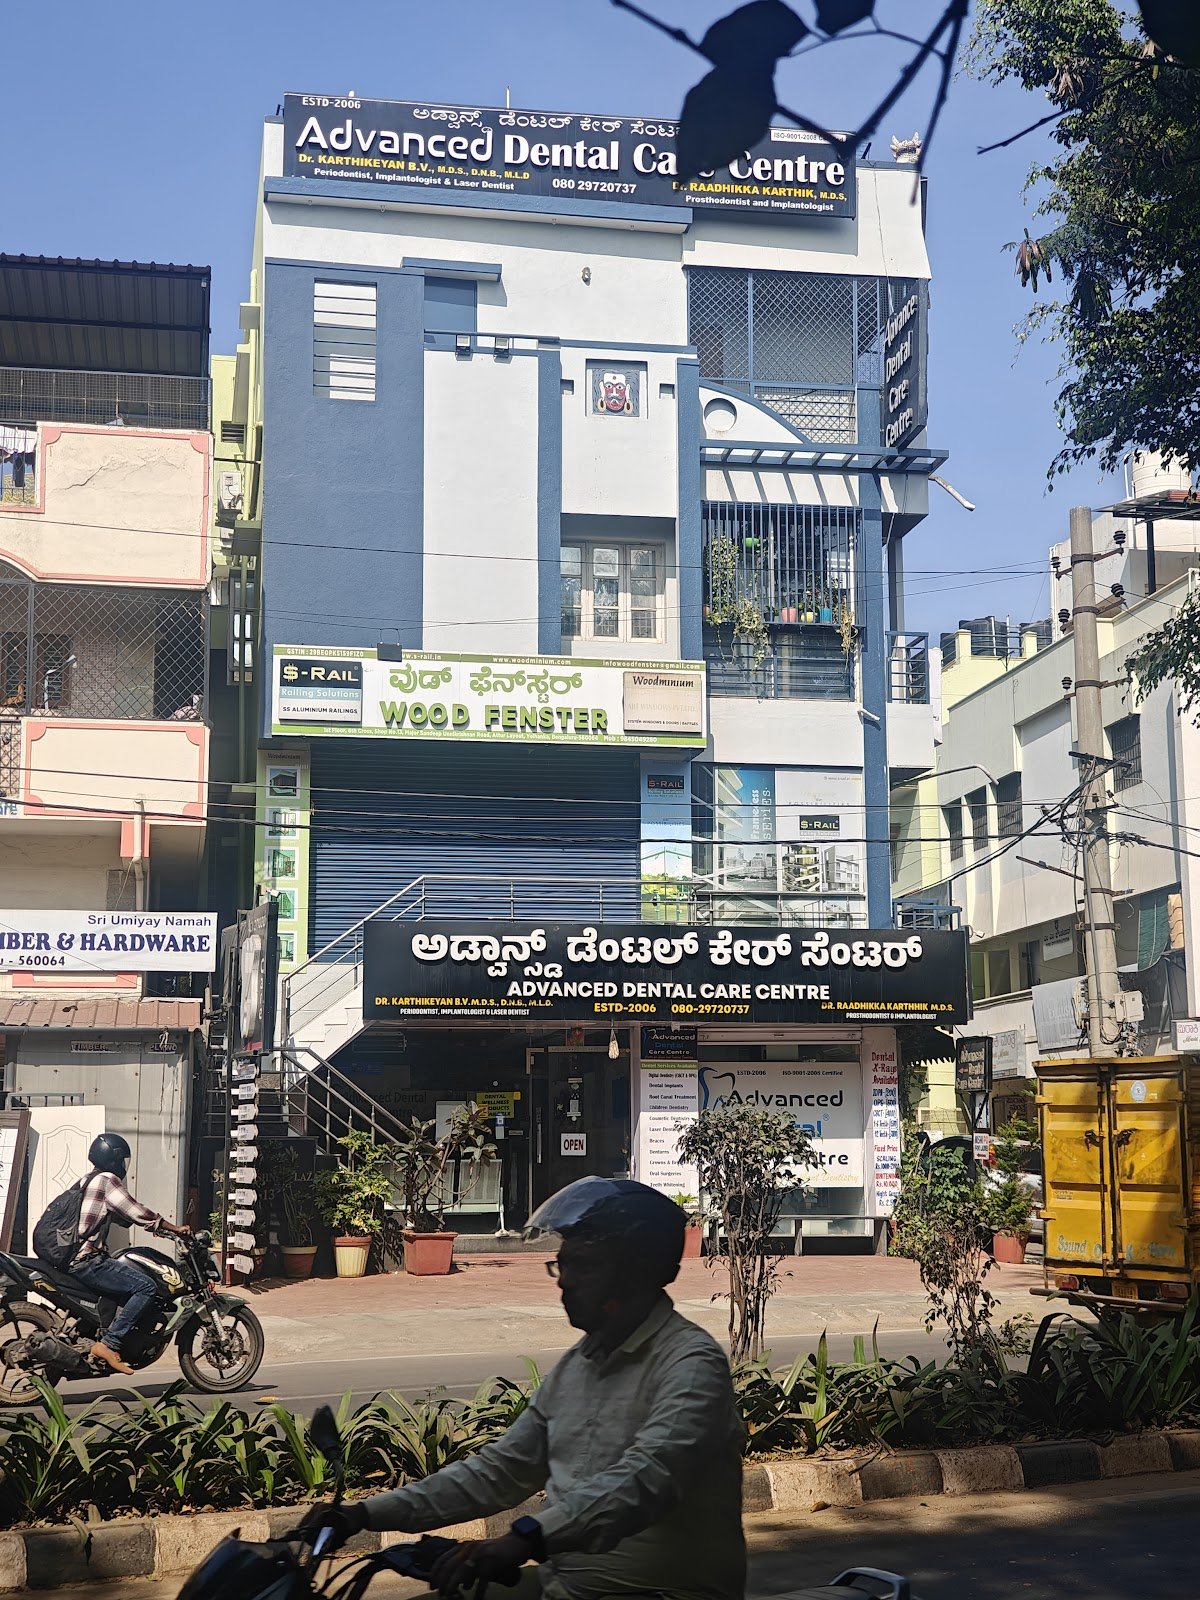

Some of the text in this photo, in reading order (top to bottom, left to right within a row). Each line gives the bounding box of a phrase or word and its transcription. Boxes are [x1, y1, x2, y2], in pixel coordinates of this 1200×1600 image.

[302, 96, 361, 109] ESTD-2006
[498, 111, 573, 129] ಡೆಂಟಲ್
[579, 117, 623, 133] ಕೇರ್
[295, 116, 846, 186] Advanced Dental Ca Centre
[298, 153, 530, 180] Dr. KARTHIKEYAN B.V., M.D.S., D.N.B., M.L.D
[314, 167, 515, 190] Periodontist, Implantologist & Laser Dentist
[553, 178, 637, 194] 080 29720737
[689, 182, 759, 195] RAADHIKKA
[762, 186, 817, 200] KARTHIK,
[685, 194, 834, 212] Prosthodontist and Implantologist
[886, 330, 914, 384] Dental
[889, 379, 909, 414] Care
[886, 407, 914, 448] Centre
[492, 656, 572, 665] www.woodminium.com
[632, 675, 695, 688] Woodminium
[281, 688, 359, 699] Railing Solutions
[379, 700, 609, 731] WOOD FENSTER
[88, 914, 211, 928] Sri Umiyay Namah
[56, 931, 75, 950] &
[79, 932, 211, 952] HARDWARE
[566, 927, 699, 964] ಡೆಂಟಲ್
[709, 930, 792, 966] ಕೇರ್
[800, 931, 922, 968] ಸೆಂಟರ್
[18, 955, 65, 967] 560064
[506, 980, 830, 1001] ADVANCED DENTAL CARE CENTRE
[375, 997, 390, 1006] DR.
[391, 997, 454, 1007] KARTHIKEYAN
[528, 1000, 553, 1008] M.L.D.
[593, 1002, 750, 1015] ESTD-2006 080-29720737
[821, 1001, 835, 1010] DR.
[837, 1002, 886, 1012] RAADHIKKA
[930, 1003, 955, 1013] M.D.S.
[400, 1008, 440, 1016] PERIODONTIST,
[440, 1008, 485, 1016] IMPLANTOLOGIST
[490, 1008, 507, 1016] LASER
[507, 1009, 530, 1017] DENTIST
[846, 1011, 890, 1020] PROSTHODONTIST
[894, 1012, 937, 1020] IMPLANTOLOGIST
[871, 1051, 895, 1062] Dental
[727, 1089, 843, 1107] Advanced
[563, 1138, 584, 1151] OPEN
[1057, 1234, 1087, 1254] Sound
